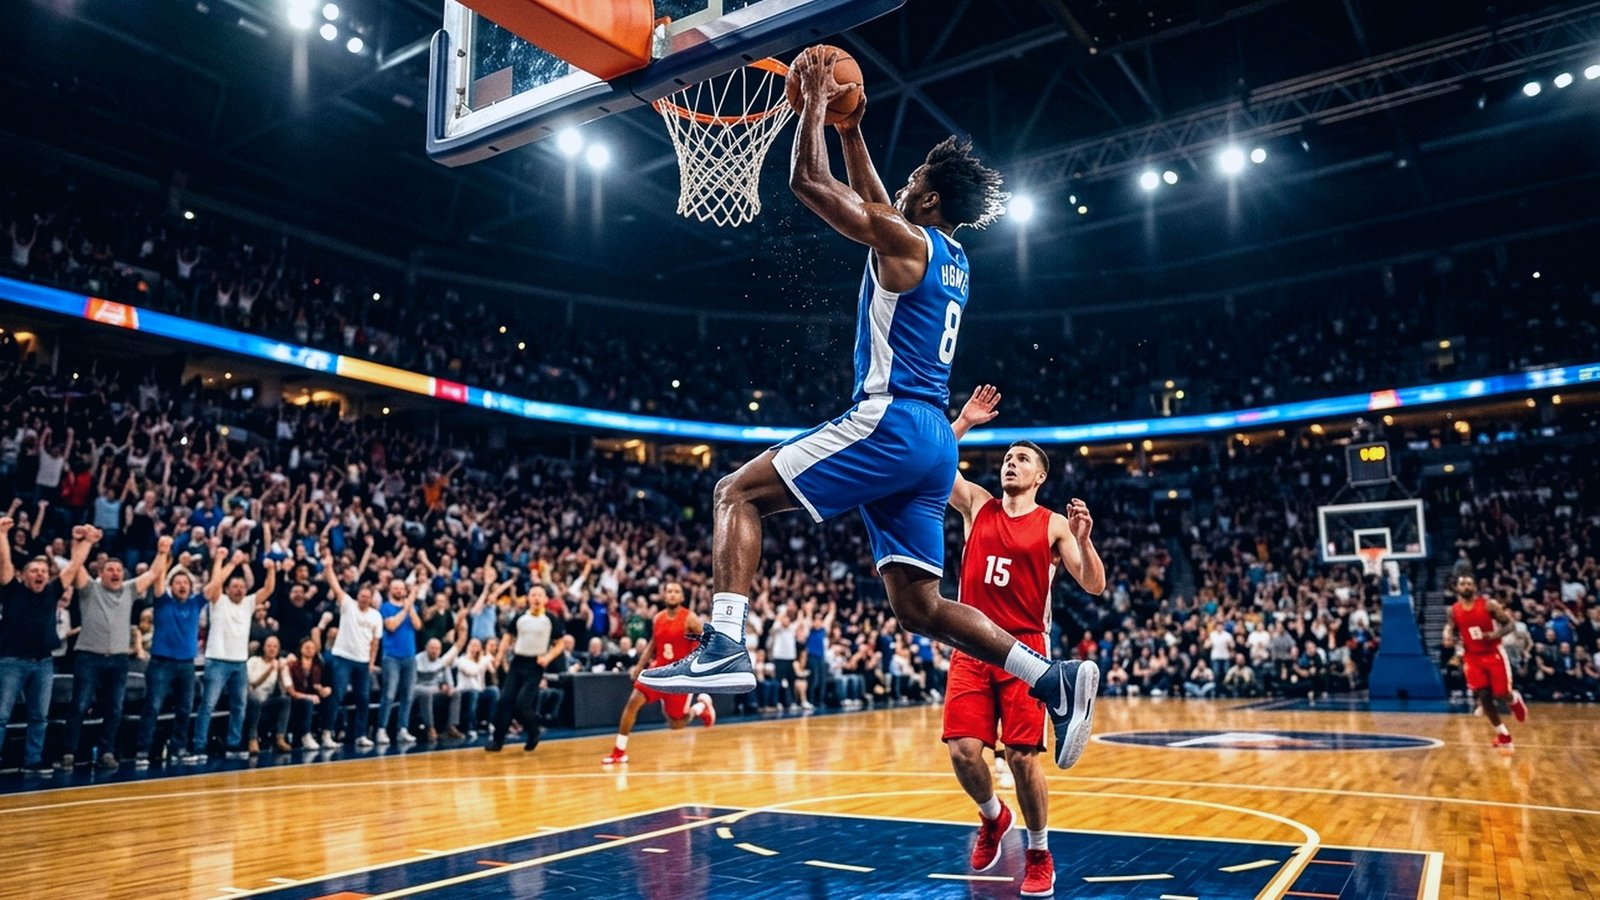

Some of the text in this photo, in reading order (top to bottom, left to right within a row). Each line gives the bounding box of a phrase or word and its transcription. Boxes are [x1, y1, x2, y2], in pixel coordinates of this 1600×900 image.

[939, 300, 961, 364] 8
[984, 555, 1012, 587] 15
[726, 605, 733, 616] 8
